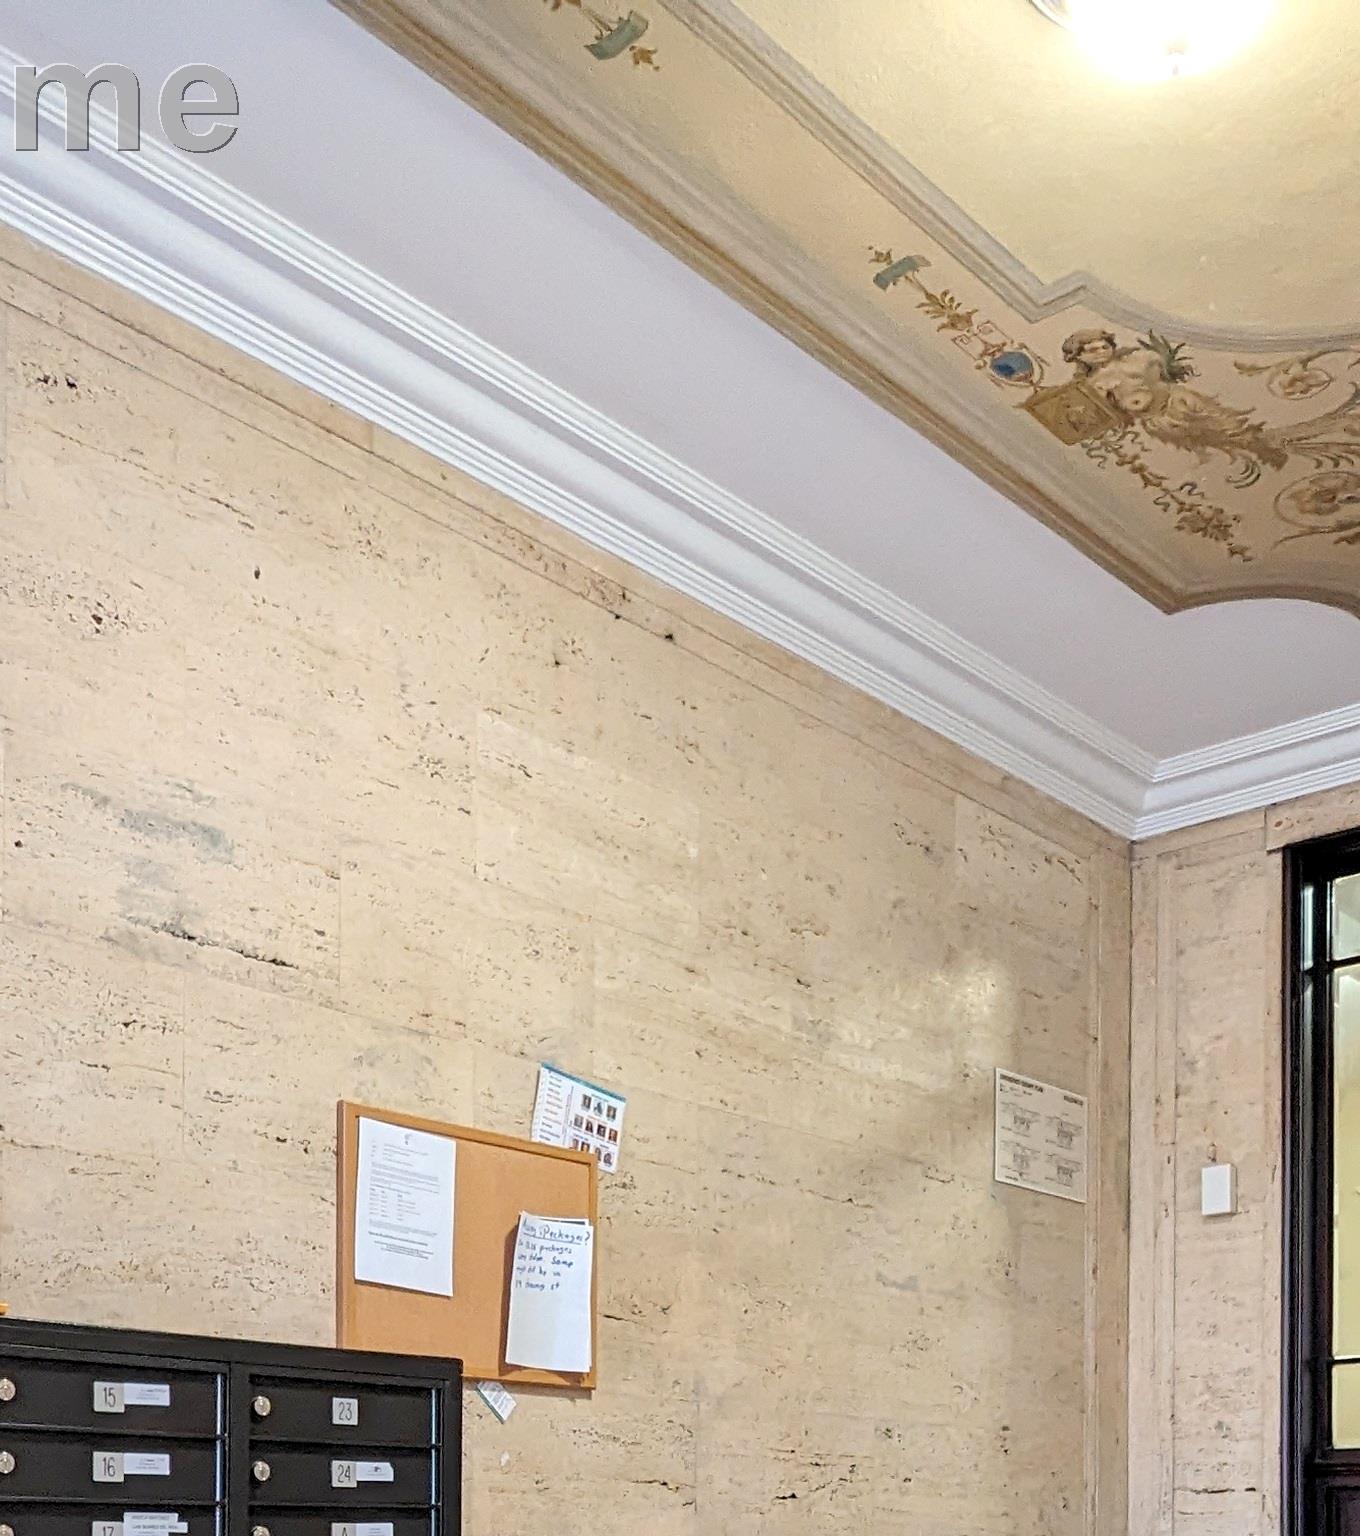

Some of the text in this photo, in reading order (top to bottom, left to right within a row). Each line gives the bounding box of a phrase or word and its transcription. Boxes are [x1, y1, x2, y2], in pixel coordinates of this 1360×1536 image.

[103, 1387, 116, 1408] 15
[338, 1401, 353, 1421] 23
[102, 1456, 116, 1478] 16
[337, 1463, 351, 1484] 24
